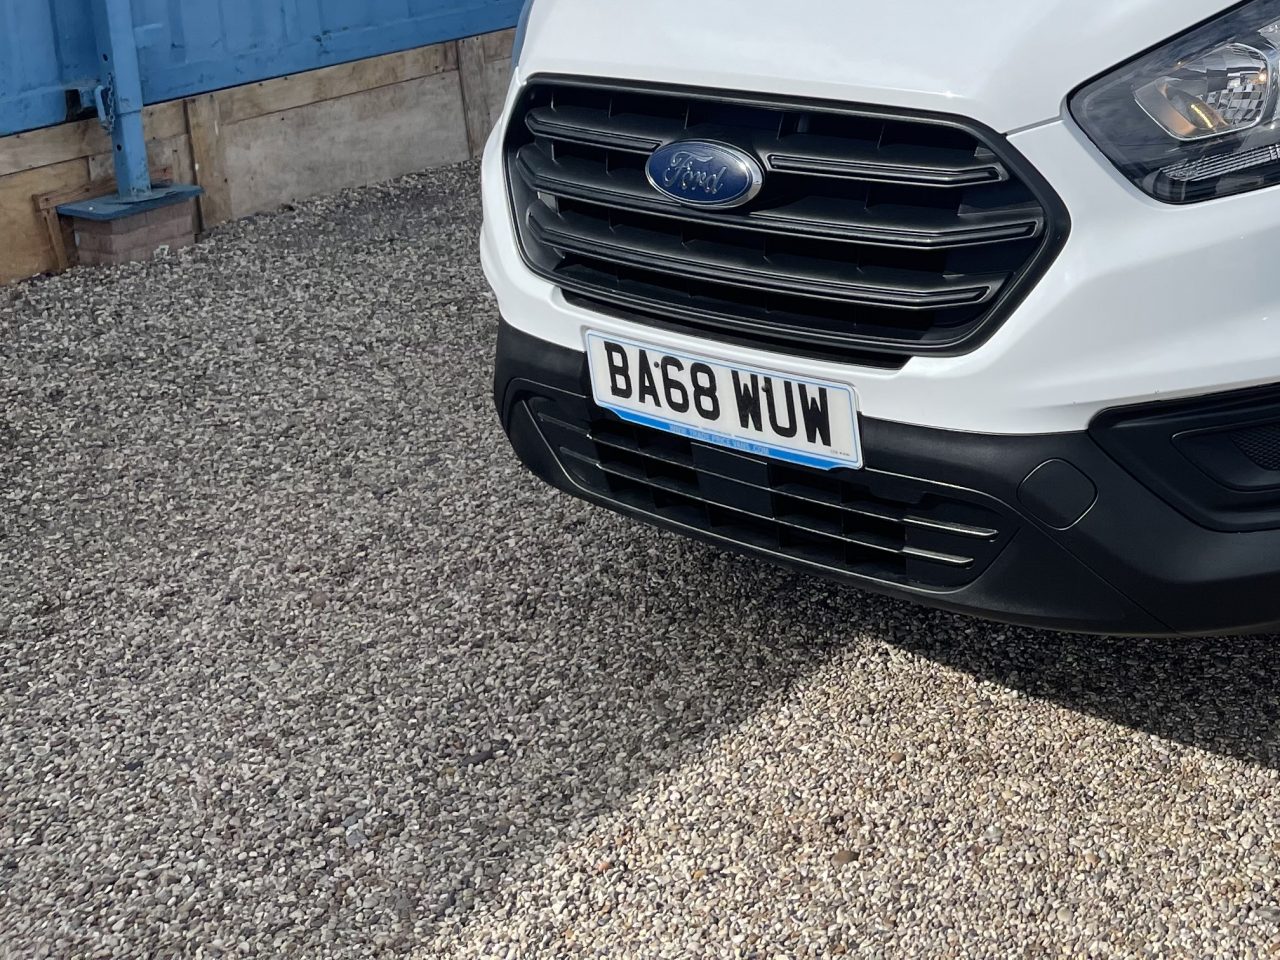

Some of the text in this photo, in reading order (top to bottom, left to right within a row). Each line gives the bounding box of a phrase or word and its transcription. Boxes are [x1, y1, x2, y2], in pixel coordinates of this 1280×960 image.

[664, 151, 728, 195] Ford
[604, 341, 832, 447] BA68 WUW
